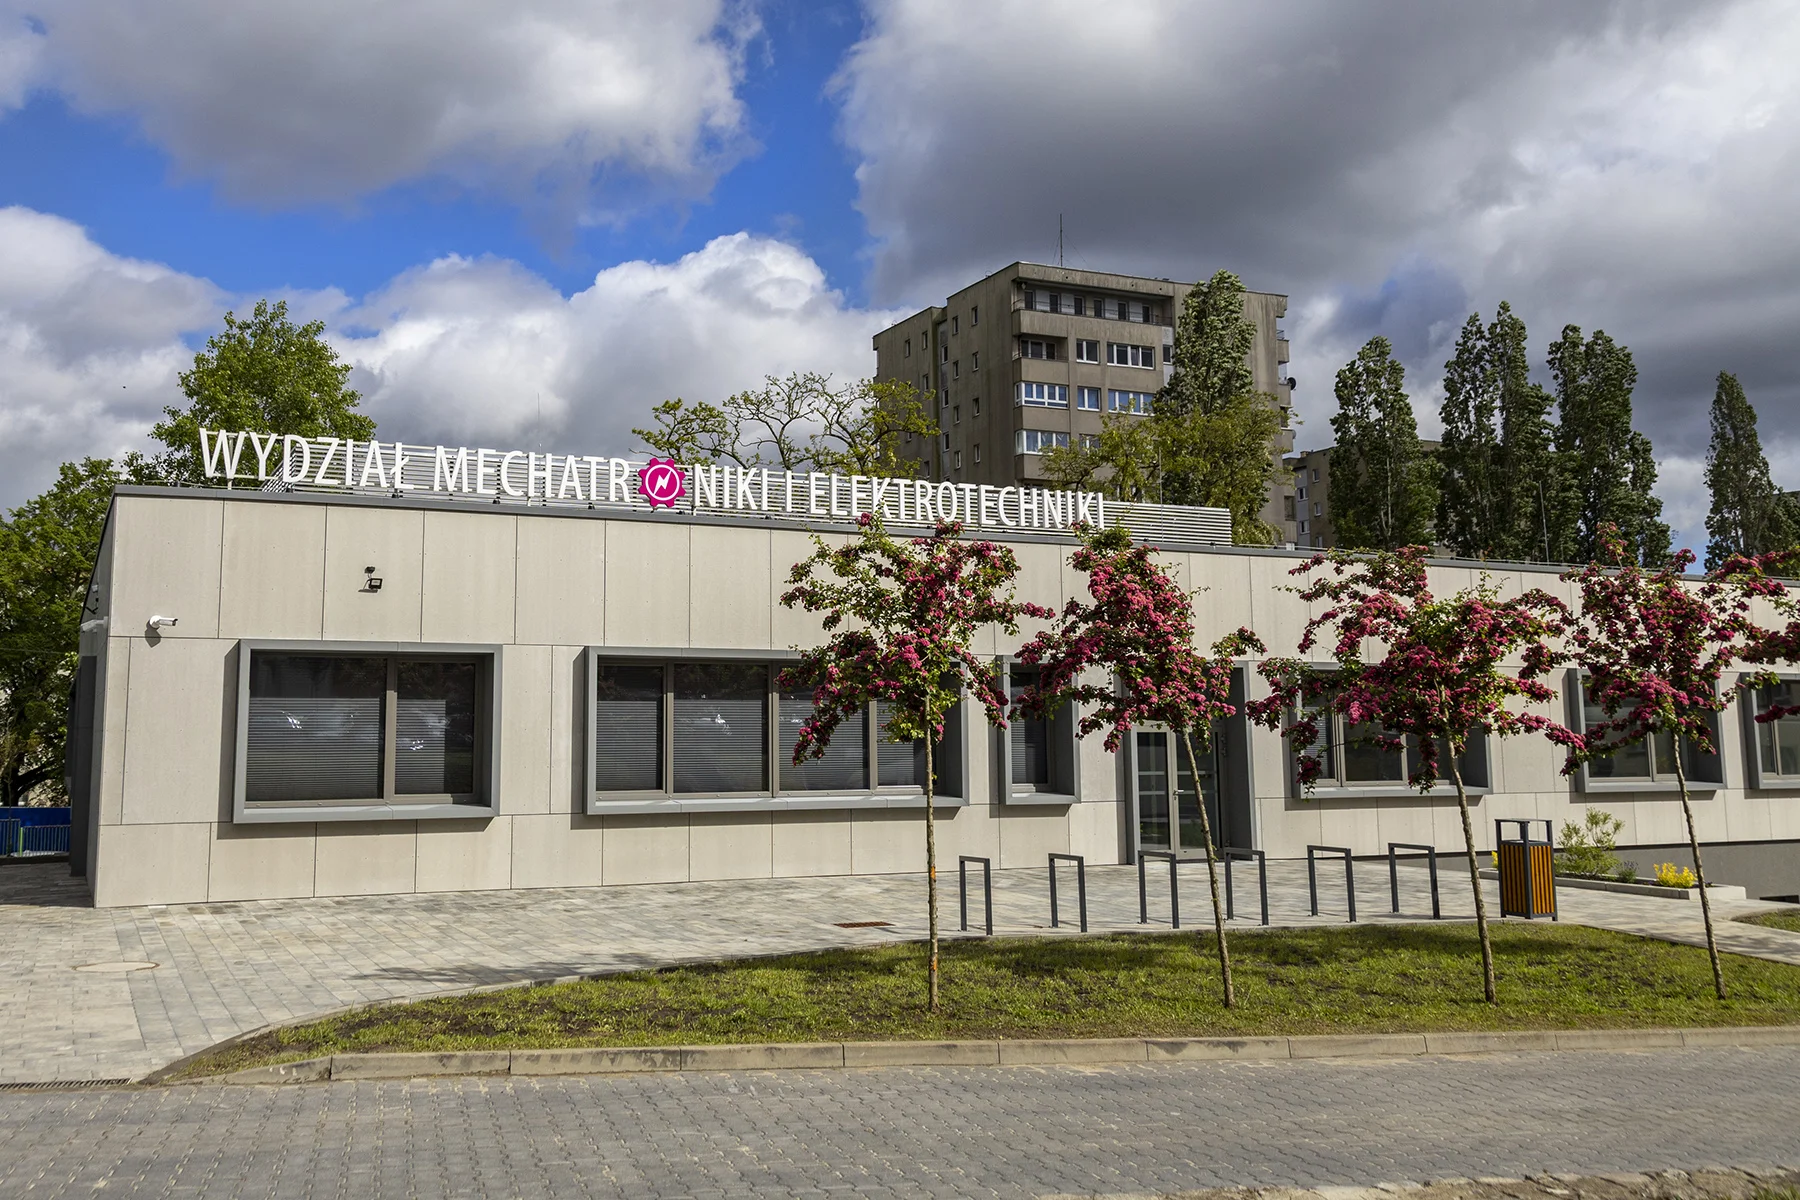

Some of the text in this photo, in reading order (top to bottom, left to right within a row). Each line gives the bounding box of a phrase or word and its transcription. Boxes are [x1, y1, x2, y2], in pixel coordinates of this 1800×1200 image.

[200, 429, 415, 489] WYDZIAŁ
[784, 469, 793, 512] I
[809, 473, 1104, 529] ELEKTROTECHNIKI
